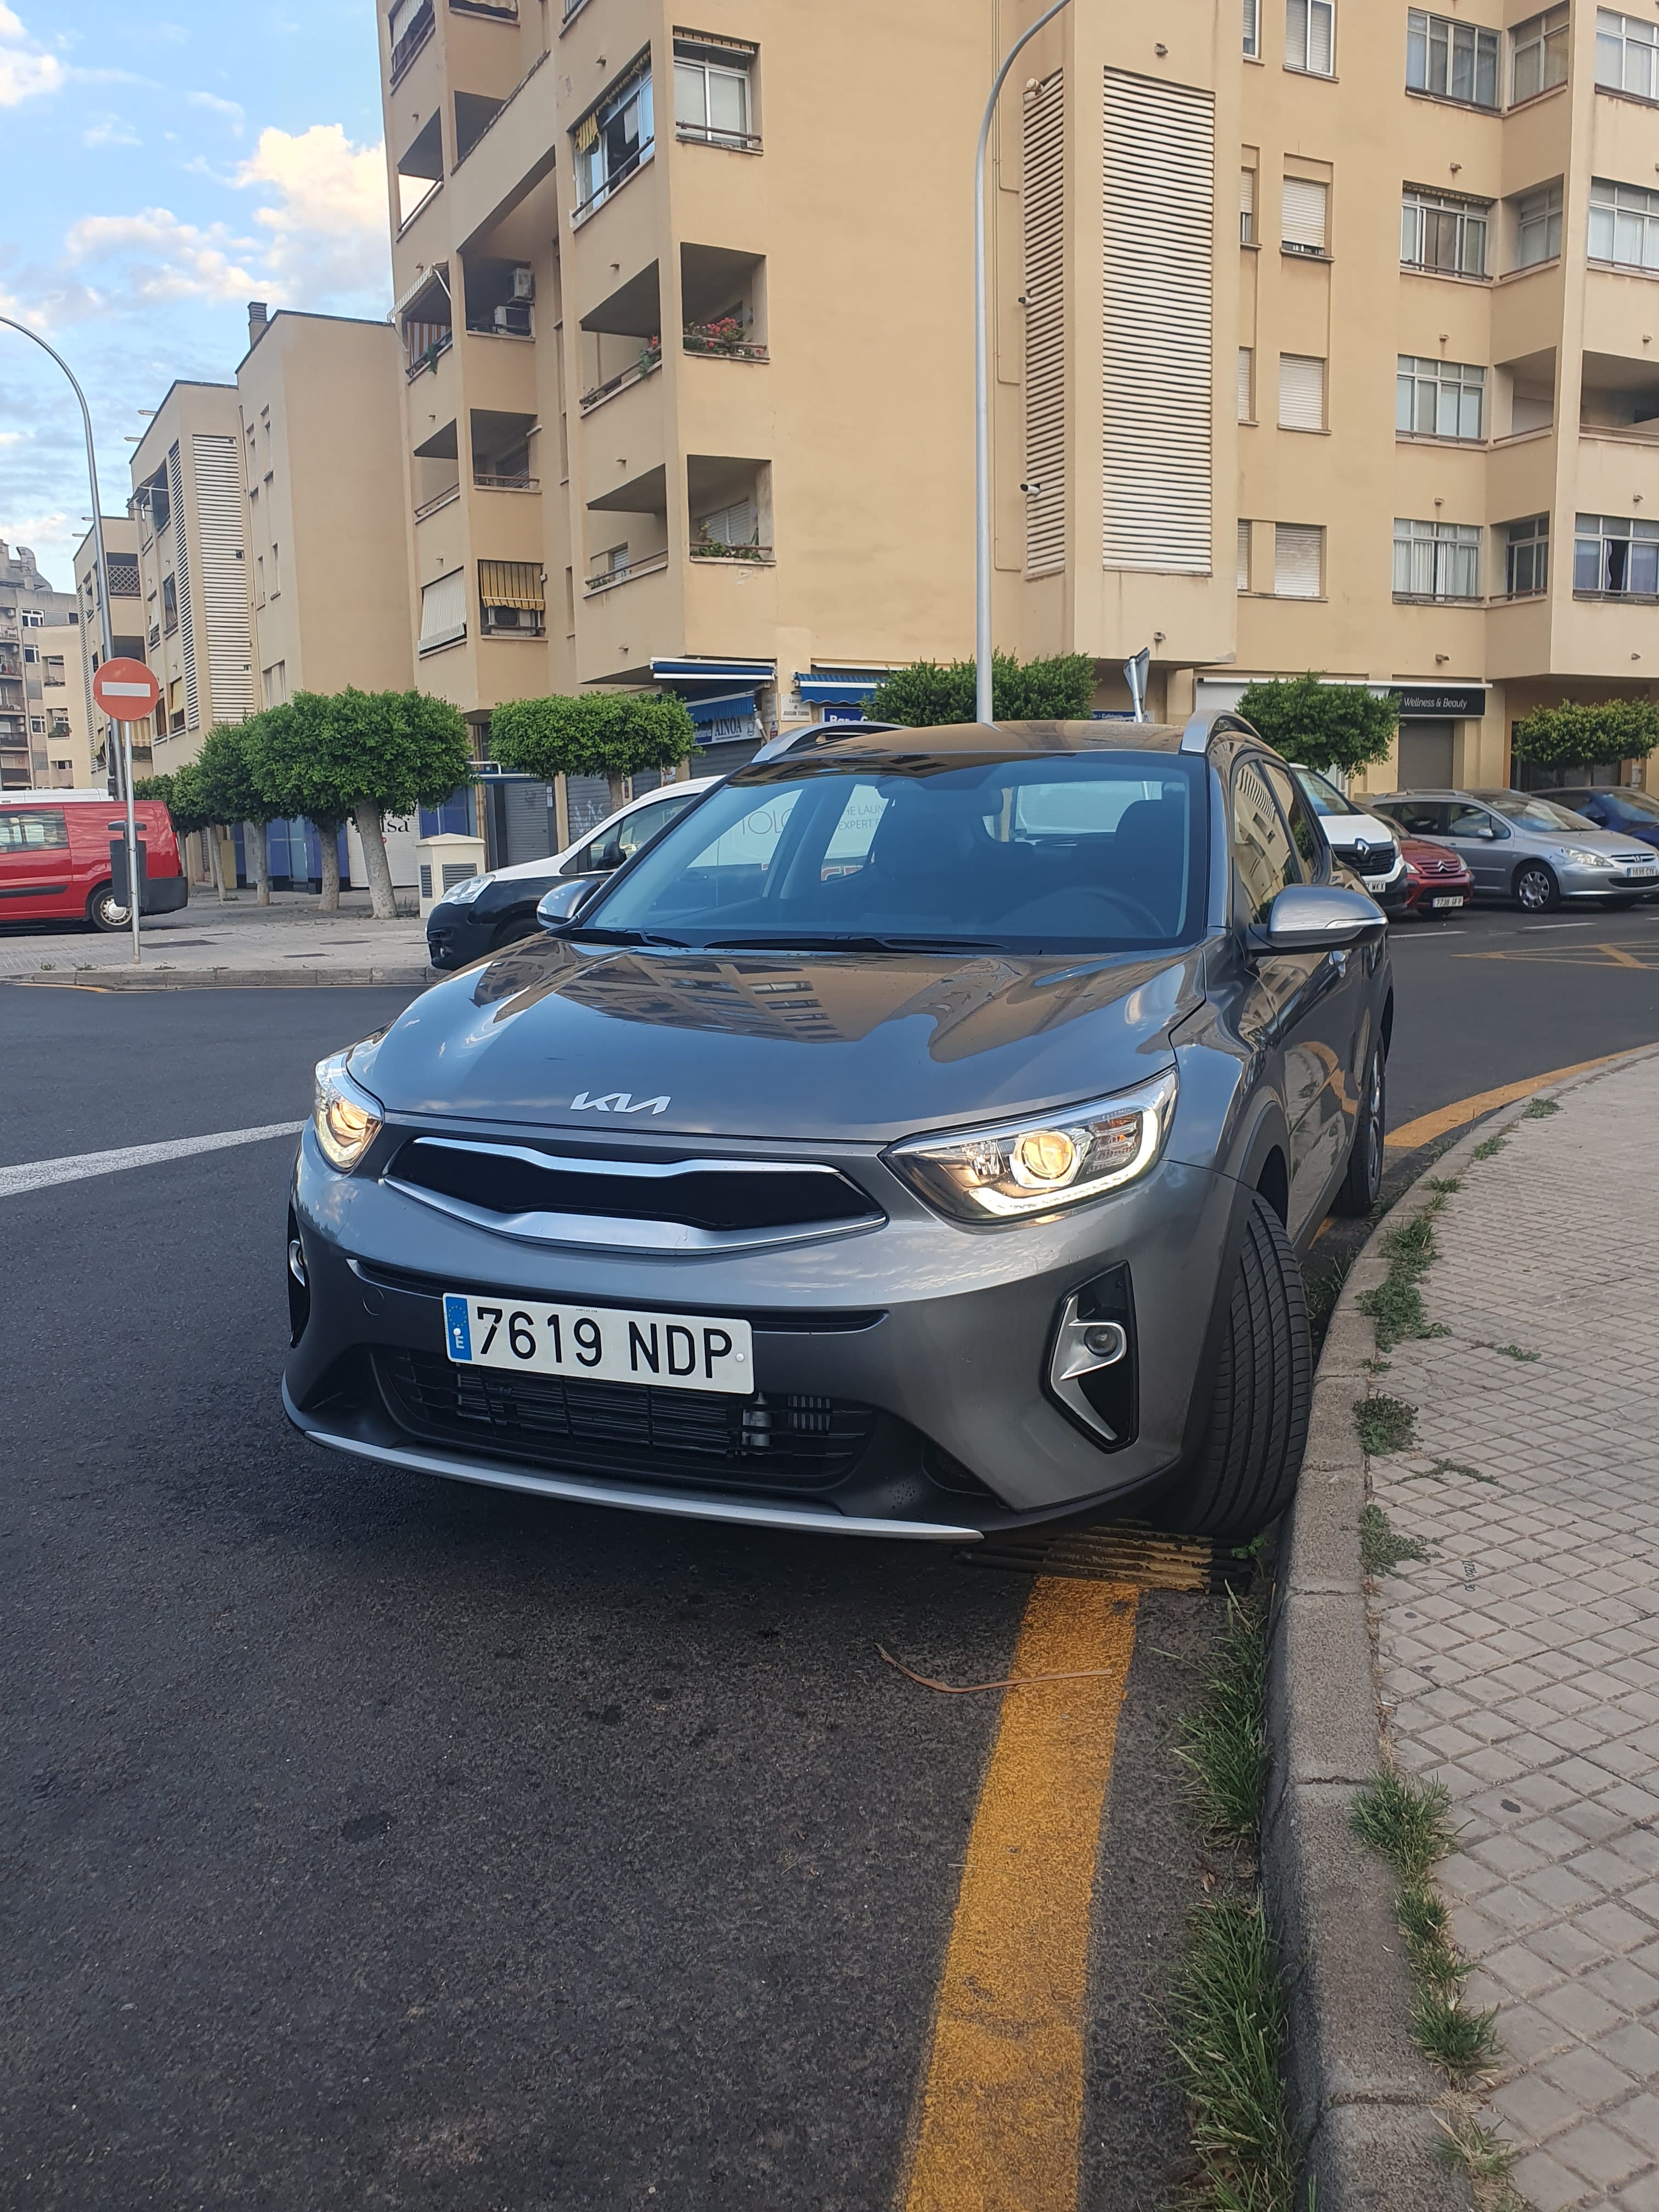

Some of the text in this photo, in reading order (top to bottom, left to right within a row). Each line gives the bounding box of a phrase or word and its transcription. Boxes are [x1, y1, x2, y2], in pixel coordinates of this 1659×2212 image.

[1404, 697, 1468, 710] Wellness & Beauty
[715, 716, 742, 736] AINOA
[838, 819, 872, 831] EXPERT
[571, 1091, 672, 1115] KIA
[455, 1335, 465, 1349] E
[477, 1306, 602, 1367] 7619
[628, 1321, 732, 1379] NDP
